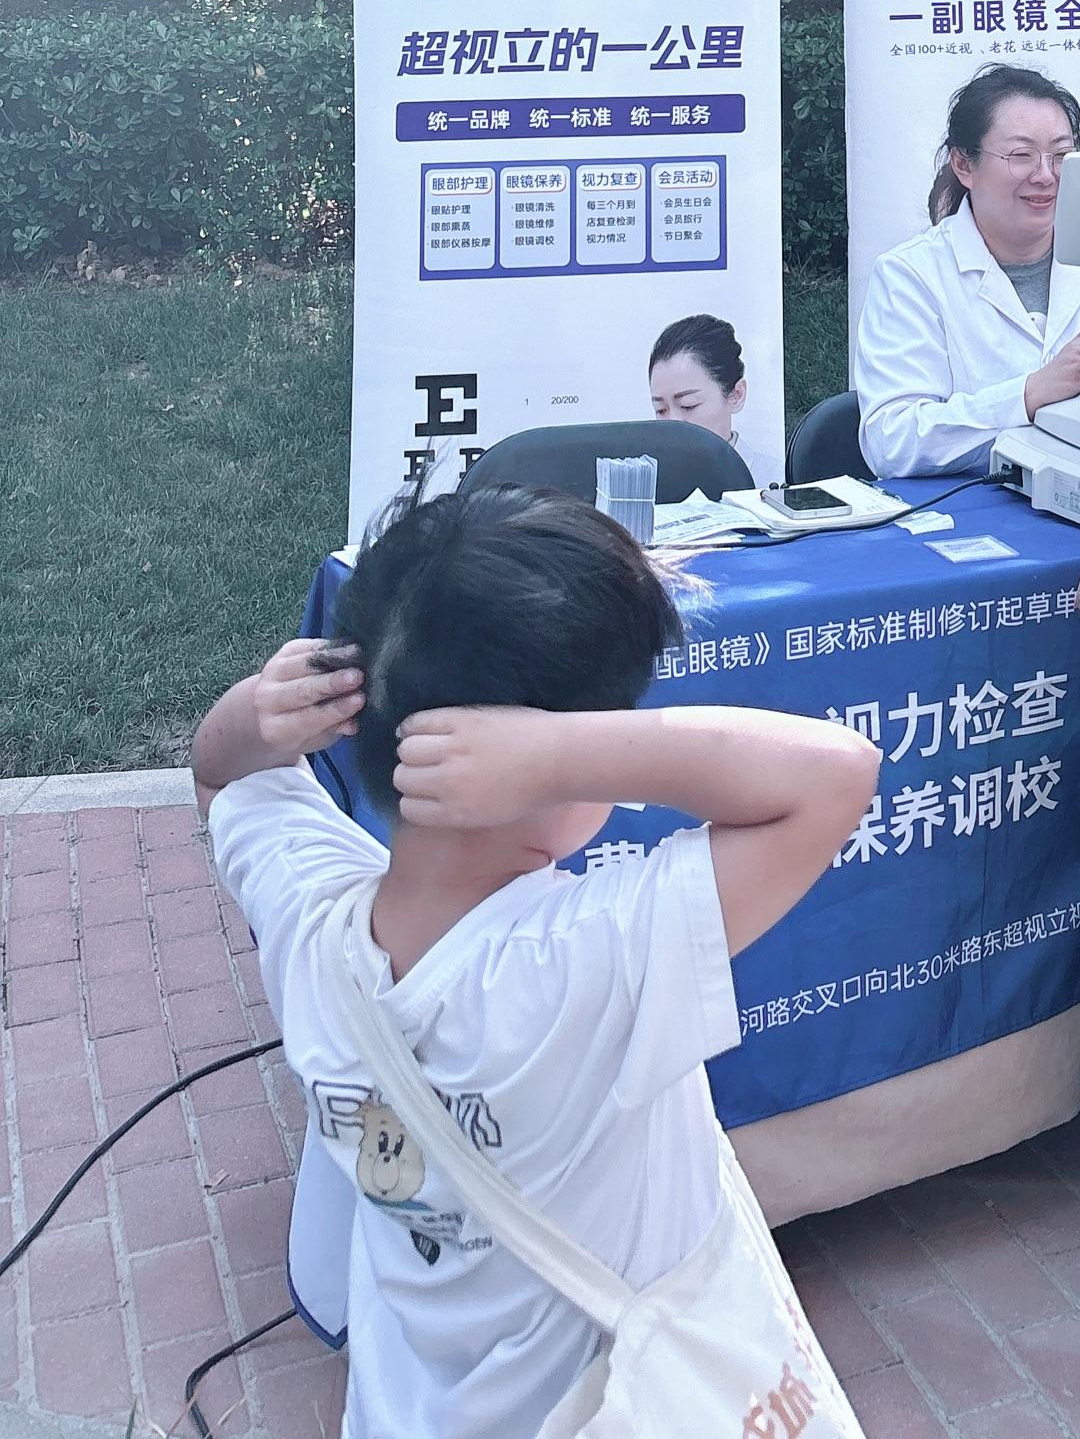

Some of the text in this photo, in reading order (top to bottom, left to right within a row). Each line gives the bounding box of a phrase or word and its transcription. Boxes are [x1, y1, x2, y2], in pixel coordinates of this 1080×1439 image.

[396, 24, 745, 77] 超视立的一公里
[427, 104, 711, 132] 统一品牌 统一标准 统一服务
[432, 176, 489, 191] 眼部护理
[506, 174, 563, 189] 眼镜保养
[582, 171, 638, 187] 视力复查
[658, 170, 713, 185] 会员活动
[513, 201, 556, 213] 眼镜清洗
[586, 199, 636, 211] 每三个月到
[663, 196, 712, 209] 会员生日会
[431, 204, 471, 216] 眼贴护理
[514, 218, 555, 230] 眼镜维修
[586, 215, 636, 228] 店复查检测
[663, 213, 703, 225] 会员旅行
[514, 235, 555, 247] 眼镜调校
[586, 232, 627, 244] 视力情况
[663, 229, 703, 242] 节日聚会
[430, 237, 491, 249] 眼部仪器按摩
[414, 373, 478, 437] E
[550, 395, 580, 405] 20/200
